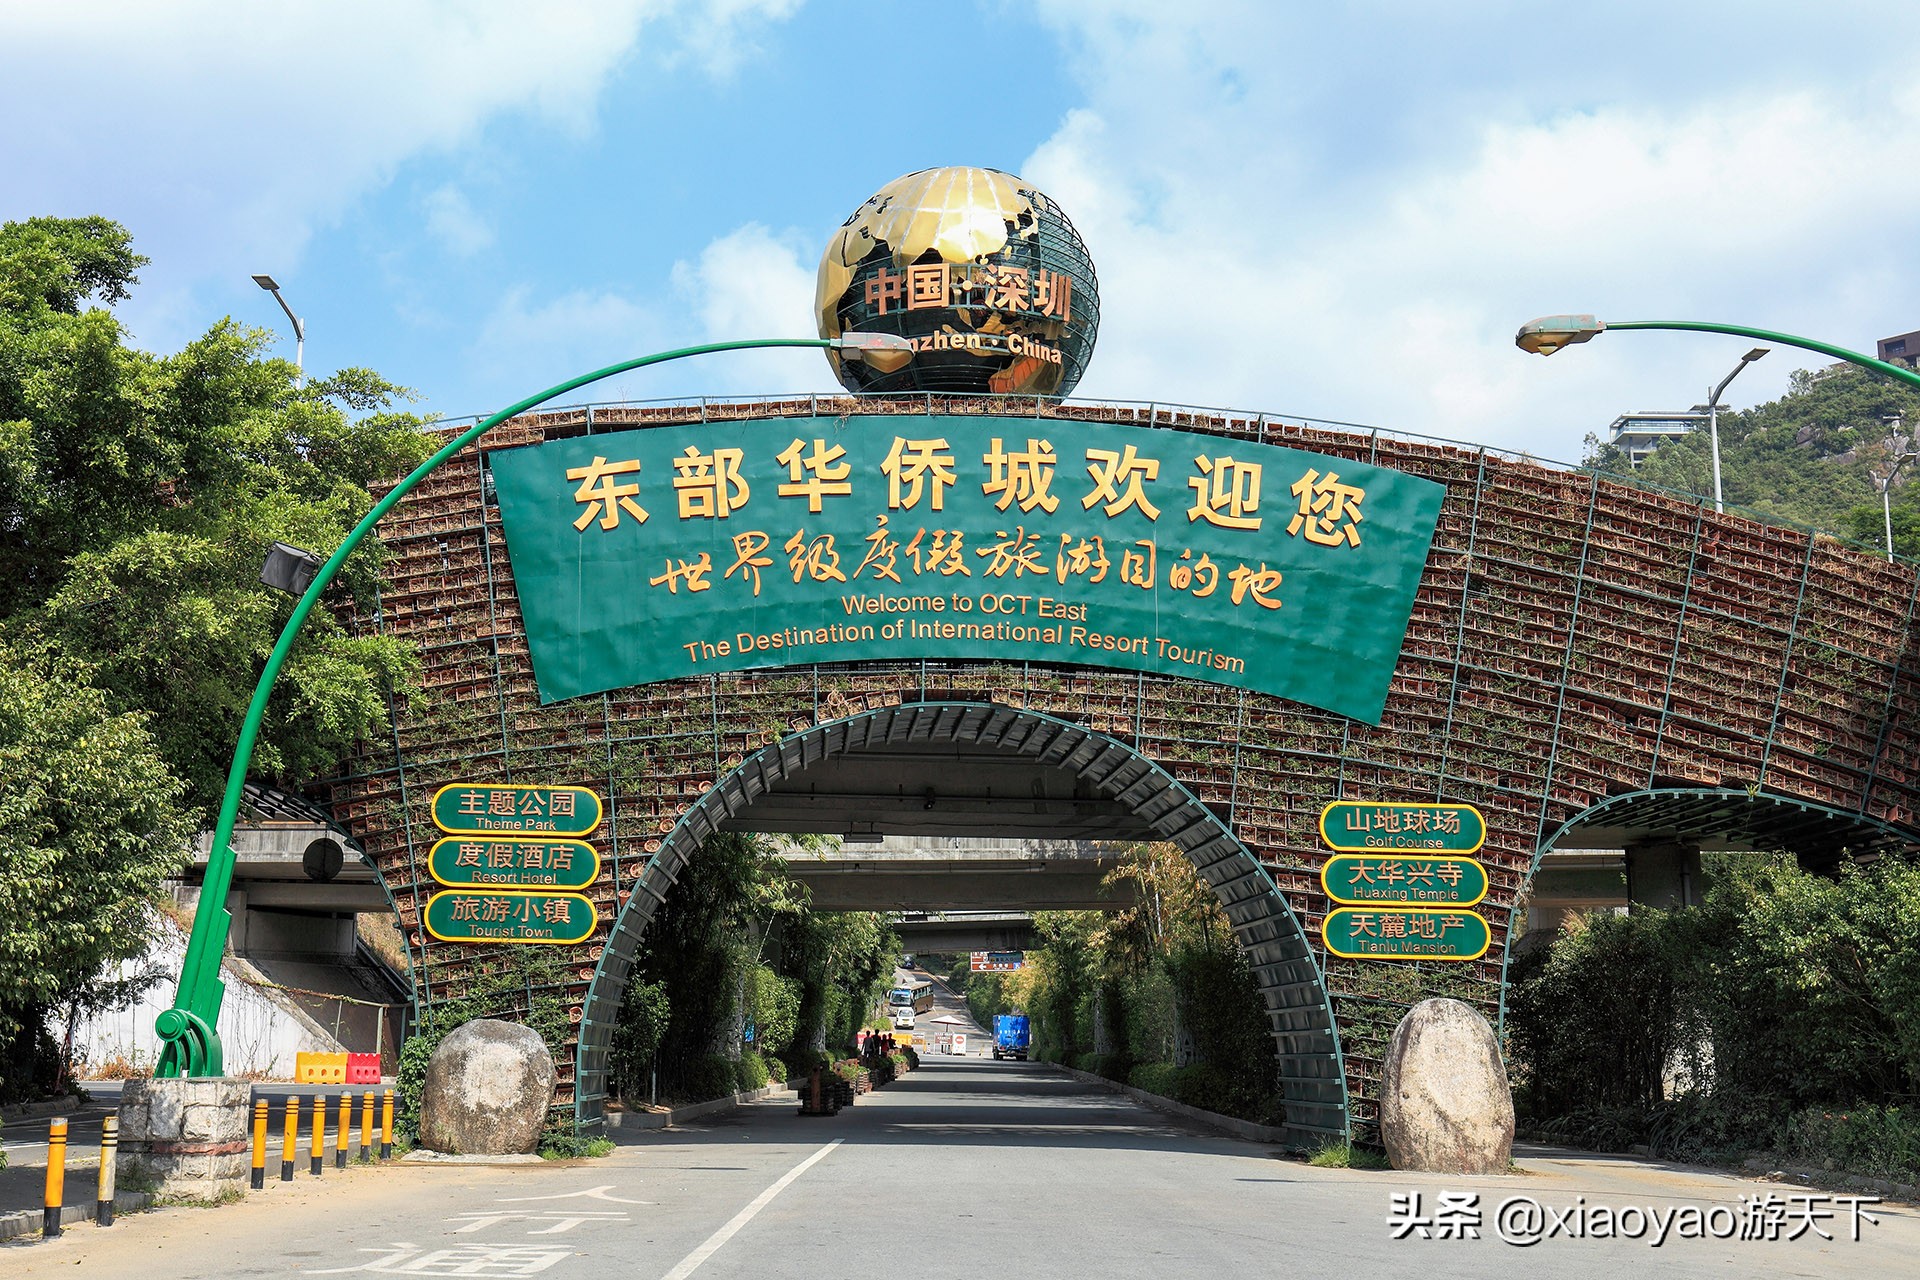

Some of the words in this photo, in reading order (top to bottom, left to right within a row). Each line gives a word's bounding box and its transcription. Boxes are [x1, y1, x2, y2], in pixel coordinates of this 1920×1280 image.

[909, 330, 981, 351] nzhen
[1007, 333, 1062, 365] China
[565, 436, 1365, 548] 东部华侨城欢迎您
[650, 514, 1283, 610] 世界级度假旅游目的地
[841, 593, 945, 615] Welcome
[952, 594, 972, 613] to
[980, 593, 1032, 615] OCT
[1038, 597, 1087, 622] East
[683, 640, 731, 663] The
[736, 623, 874, 654] Destination
[882, 618, 904, 640] of
[911, 620, 1063, 645] International
[1069, 626, 1149, 655] Resort
[1155, 638, 1245, 674] Tourism
[458, 790, 575, 818] 主题公园
[475, 818, 522, 830] Theme
[525, 819, 556, 831] Park
[1346, 808, 1460, 834] 山地球场
[455, 842, 574, 870] 度假酒店
[1365, 836, 1392, 847] Golf
[1396, 836, 1444, 849] Course
[472, 871, 517, 884] Resort
[521, 872, 556, 885] Hotel
[1348, 860, 1463, 887] 大华兴寺
[1353, 887, 1407, 902] Huaxing
[1411, 888, 1458, 901] Temple
[451, 896, 571, 924] 旅游小镇
[469, 924, 514, 937] Tourist
[517, 926, 553, 938] Town
[1349, 914, 1464, 939] 天麓地产
[1402, 941, 1456, 953] Mansion
